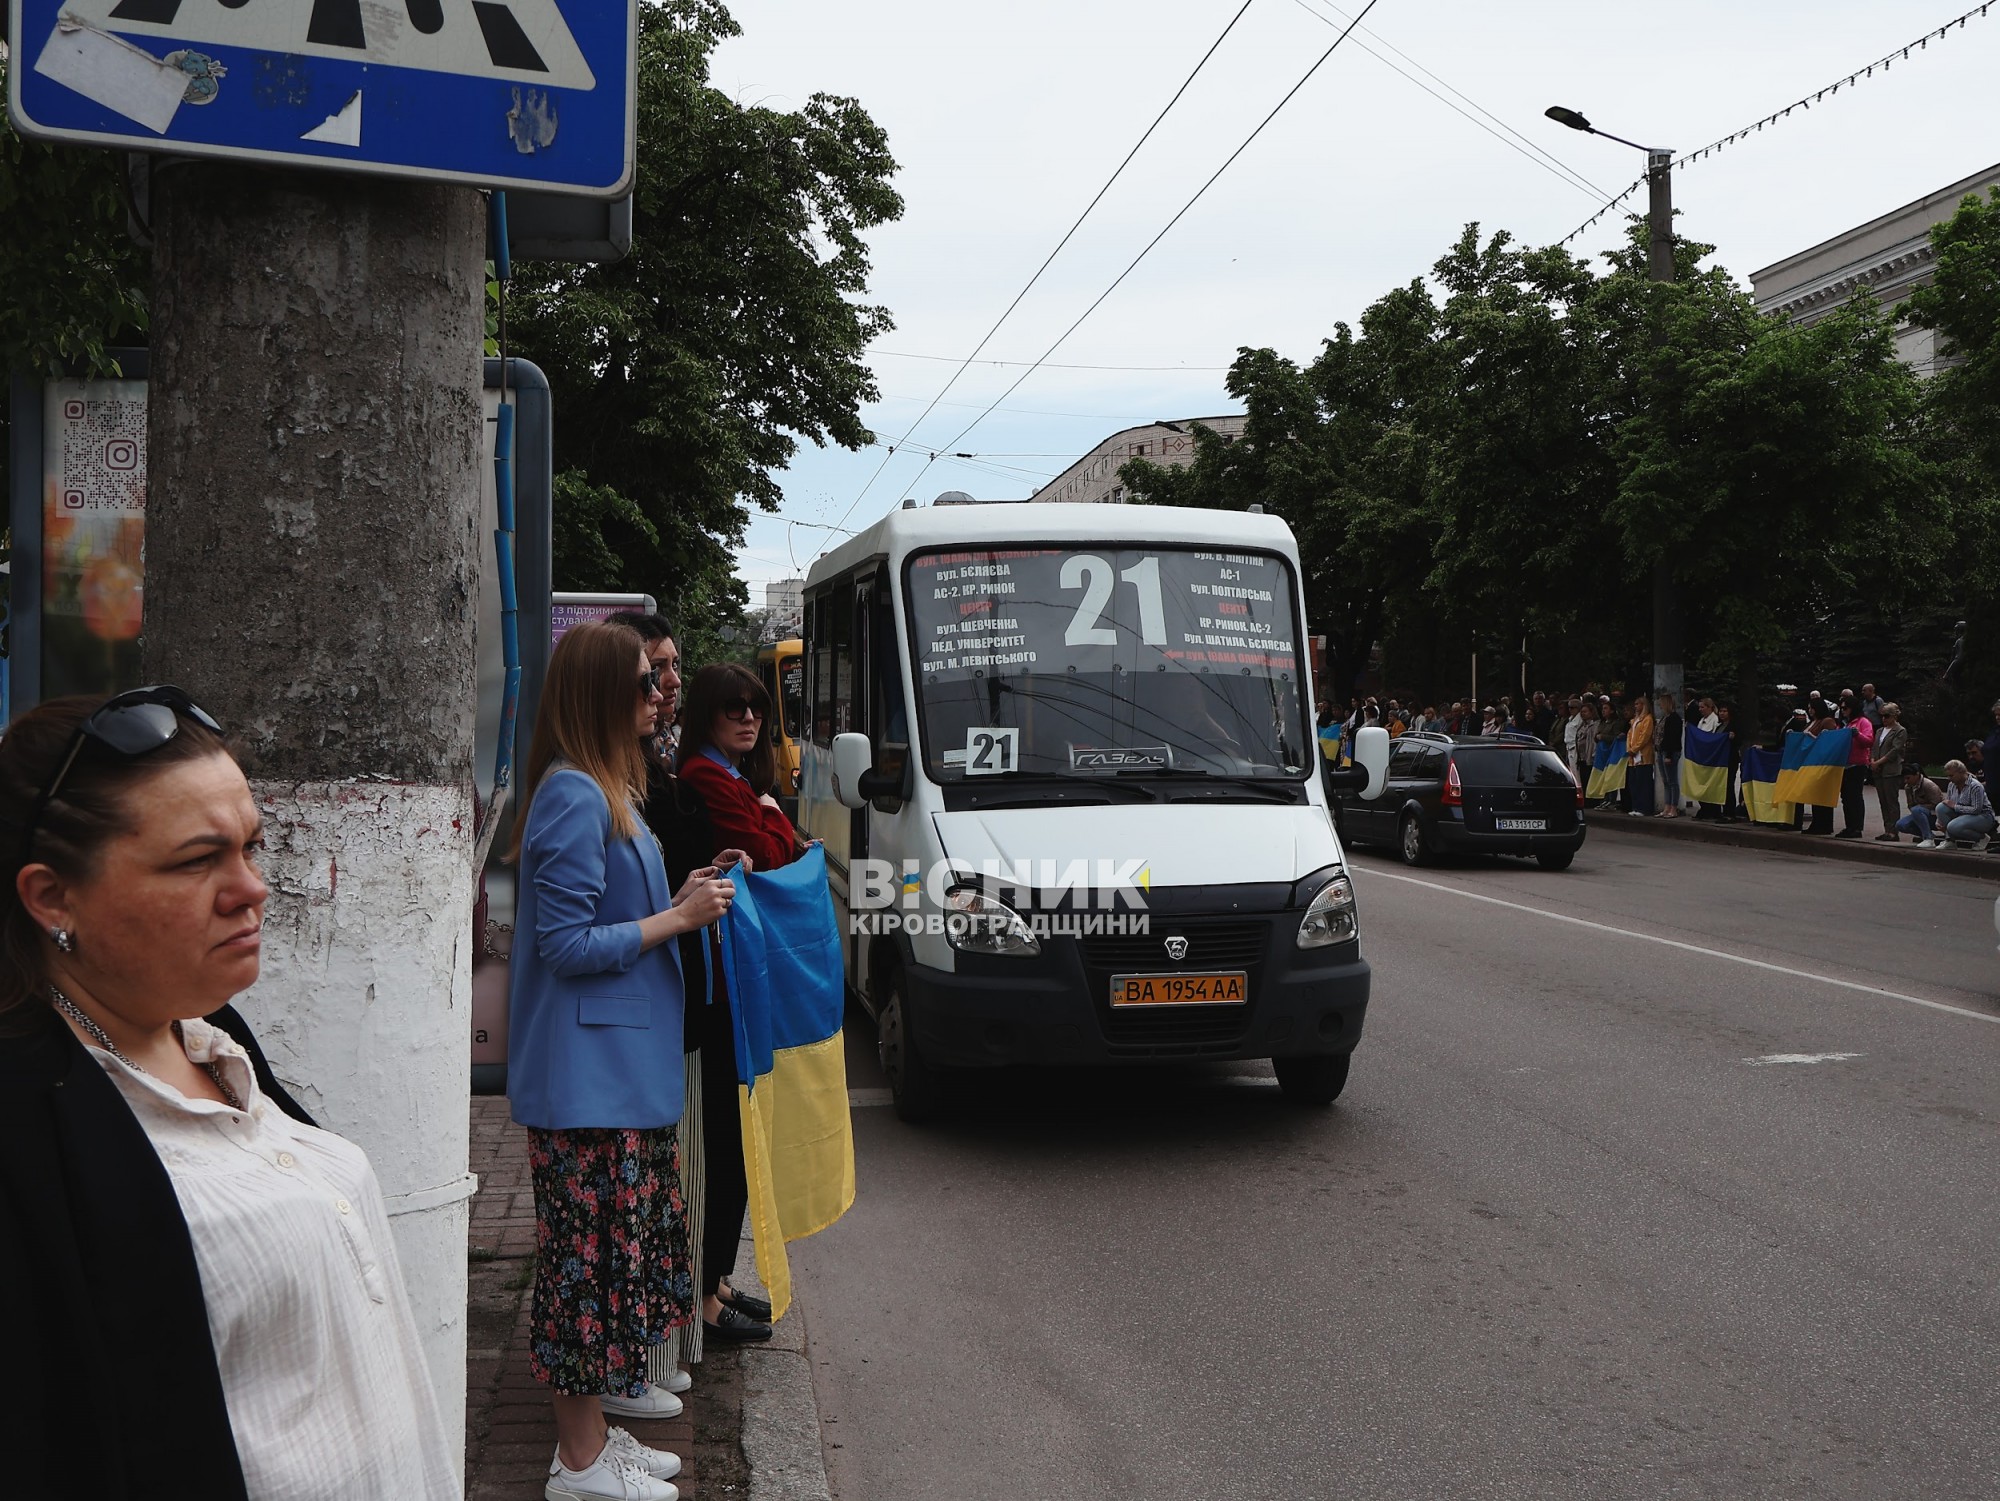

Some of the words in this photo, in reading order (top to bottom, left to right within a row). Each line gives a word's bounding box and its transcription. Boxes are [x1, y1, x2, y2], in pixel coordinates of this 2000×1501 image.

[936, 570, 959, 581] вул.
[960, 564, 1011, 577] БЄЛЯЄВА
[1220, 568, 1241, 581] АС-1
[934, 587, 960, 599] АС-2.
[962, 585, 979, 596] КР.
[980, 583, 1015, 595] РИНОК
[1190, 583, 1210, 595] вул.
[1211, 585, 1272, 602] ПОЛТАВСЬКА
[960, 601, 992, 615] ЦЕНТР
[1060, 554, 1167, 646] 21
[1218, 602, 1248, 615] ЦЕНТР
[936, 624, 959, 635] вул.
[961, 618, 1018, 632] ШЕВЧЕНКА
[1199, 617, 1214, 629] КР.
[1215, 619, 1249, 632] РИНОК.
[1250, 622, 1271, 634] АС-2
[931, 641, 956, 653] ПЕД.
[957, 635, 1026, 650] УНІВЕРСИТЕТ
[1184, 633, 1204, 645] вул.
[1248, 638, 1293, 652] БЄЛЯЄВА
[923, 661, 946, 672] вул.
[947, 658, 960, 669] М.
[961, 652, 1037, 667] ЛЕВИТСЬКОГО
[972, 733, 1012, 769] 21
[1127, 981, 1155, 1001] BA
[1162, 980, 1206, 1000] 1954
[1212, 979, 1240, 998] AA
